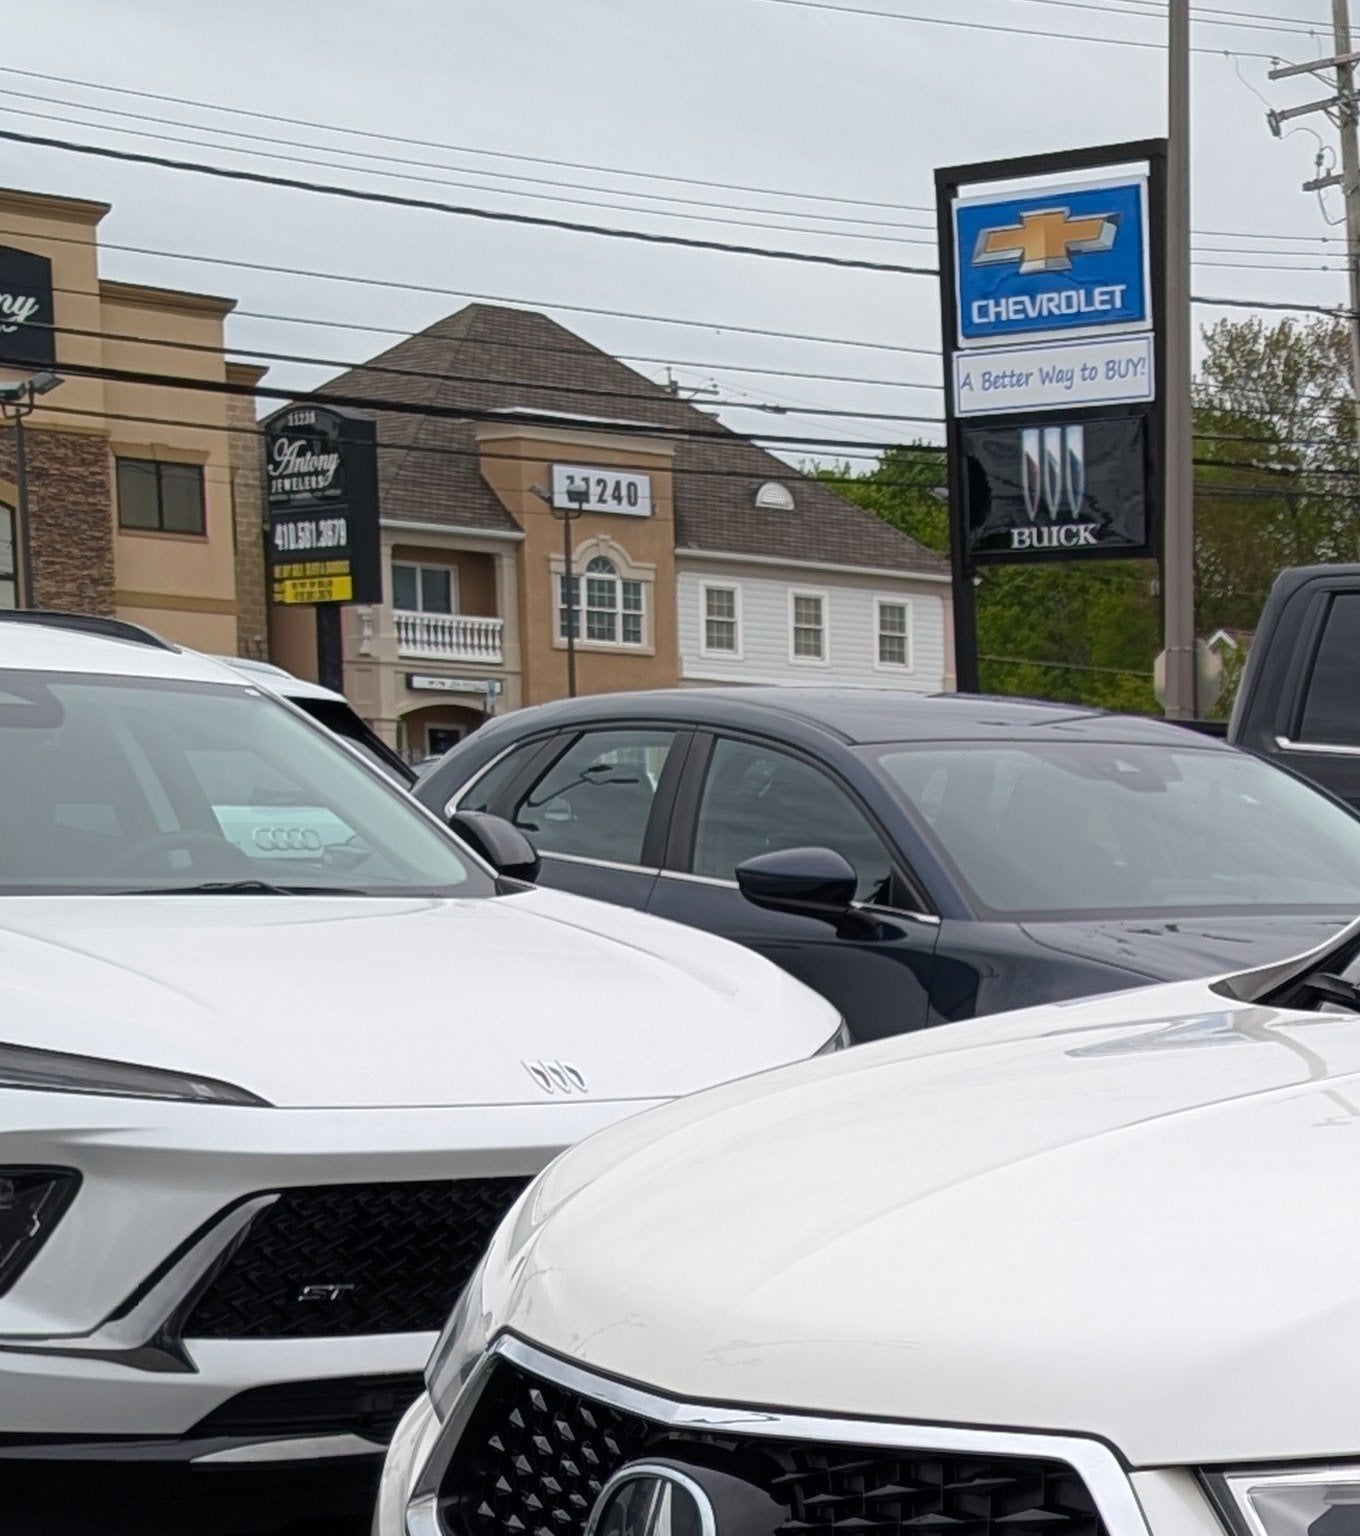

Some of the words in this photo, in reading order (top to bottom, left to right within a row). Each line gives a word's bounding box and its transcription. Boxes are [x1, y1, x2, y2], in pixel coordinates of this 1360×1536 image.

[971, 284, 1127, 325] CHEVROLET
[960, 372, 974, 391] A
[981, 368, 1033, 392] Better
[1039, 365, 1074, 390] Way
[1080, 363, 1098, 381] to
[1105, 357, 1146, 380] BUY!
[267, 438, 341, 486] Antony
[1010, 523, 1098, 549] BUICK
[298, 1284, 355, 1302] ST
